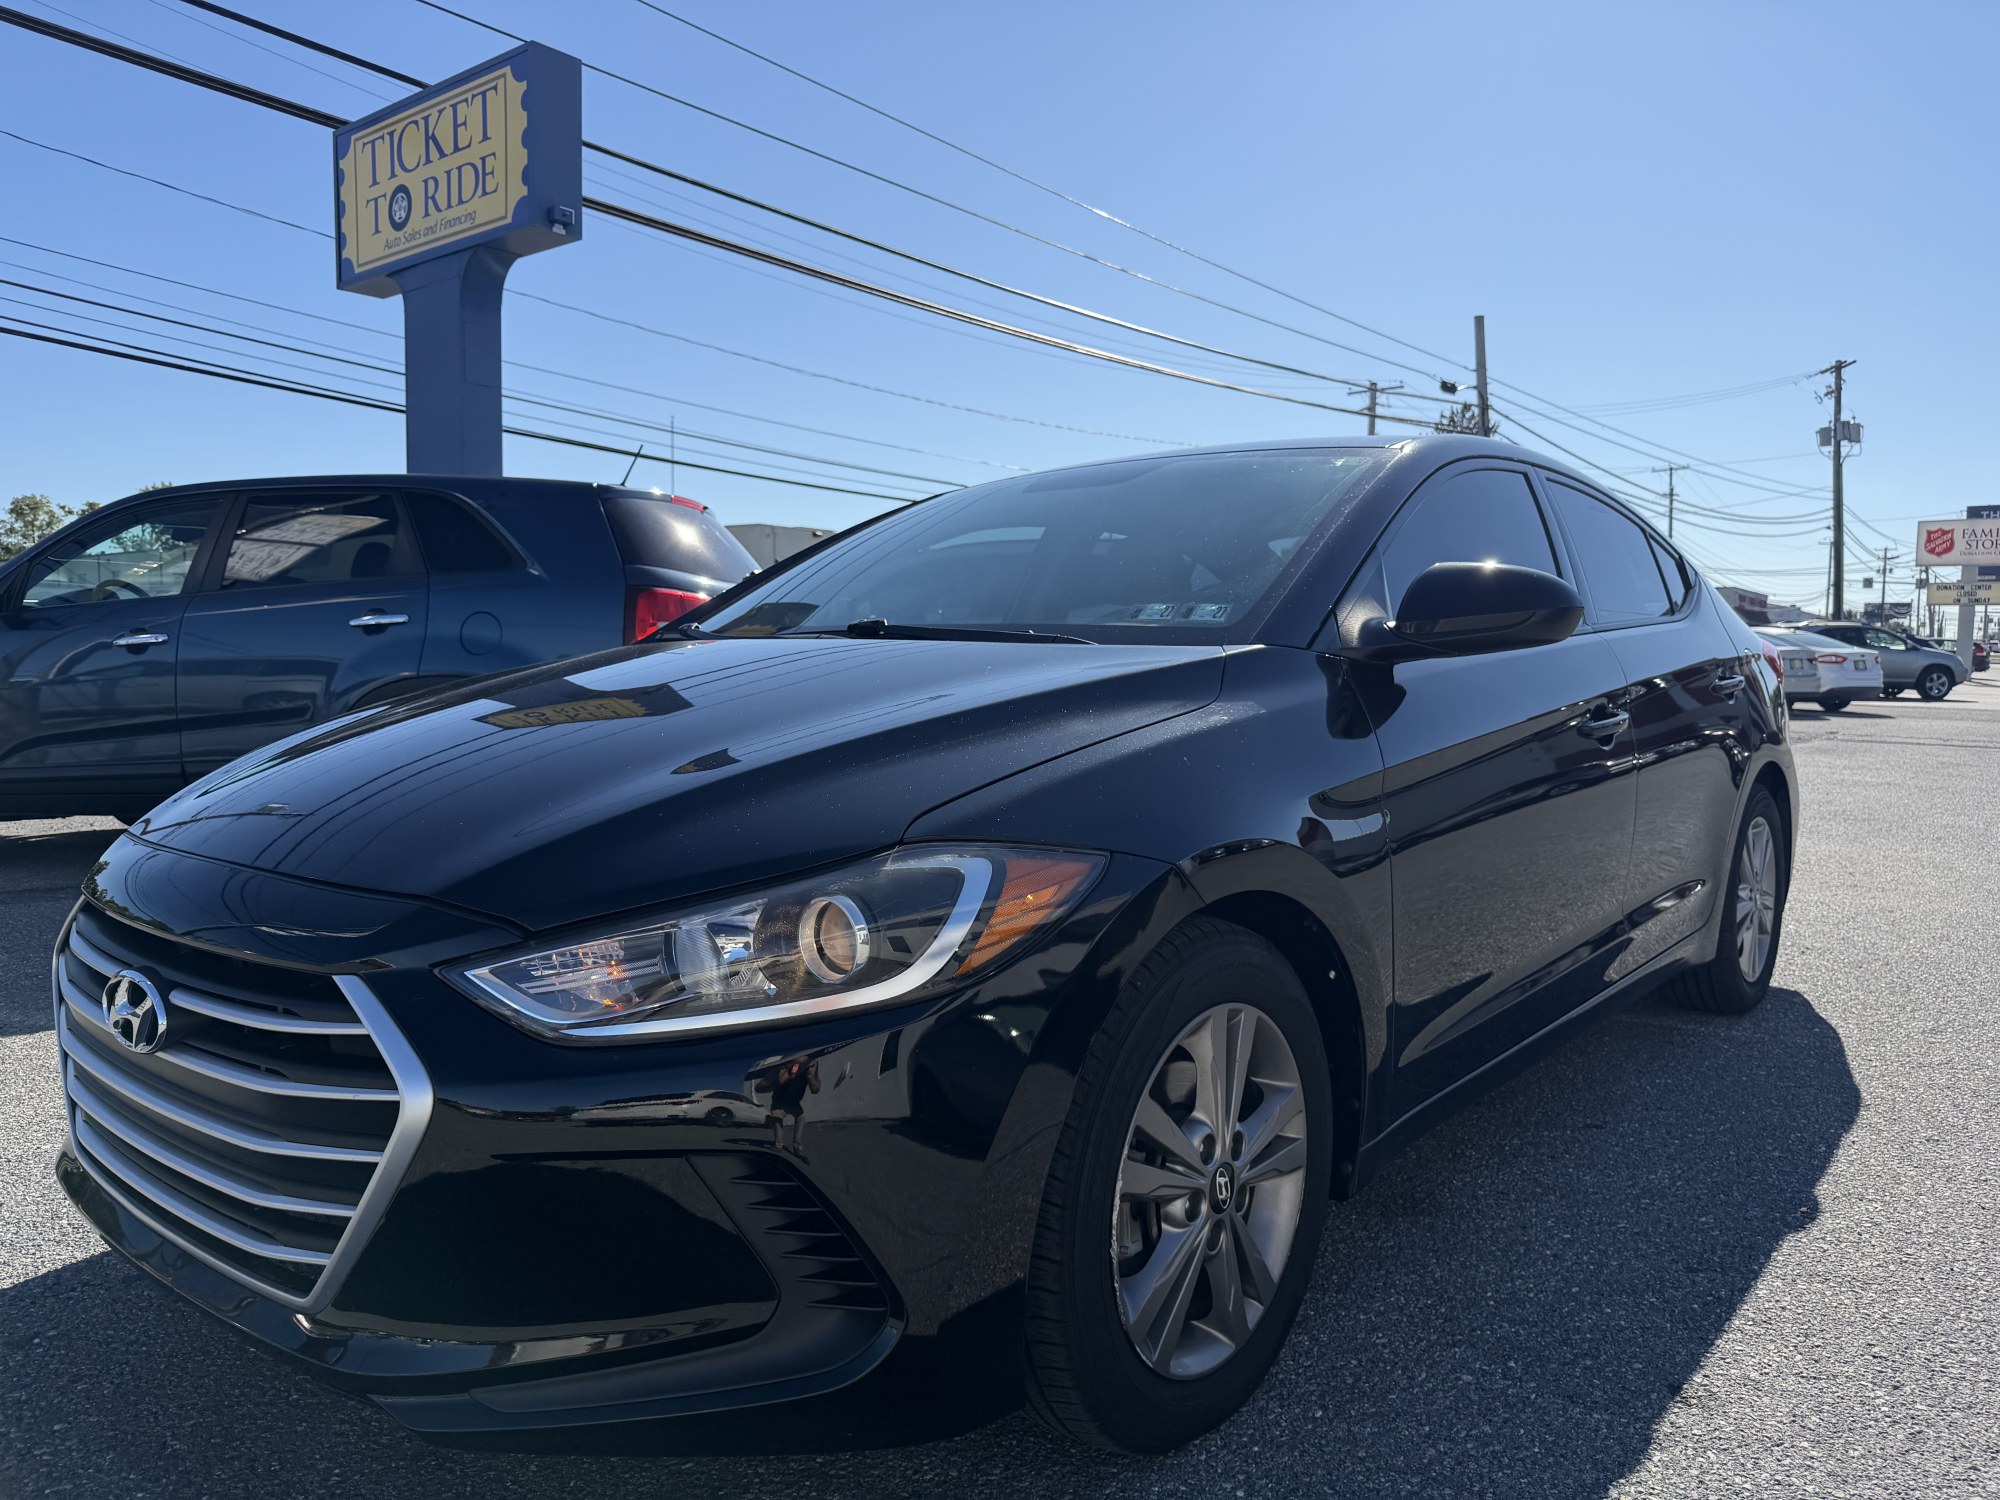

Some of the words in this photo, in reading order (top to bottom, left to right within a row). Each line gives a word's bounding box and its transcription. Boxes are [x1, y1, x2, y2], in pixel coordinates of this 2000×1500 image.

[362, 84, 498, 188] TICKET
[366, 184, 412, 236] TO
[421, 152, 500, 219] RIDE
[383, 234, 402, 252] Auto
[402, 228, 422, 245] Sales
[422, 221, 439, 238] and
[439, 209, 477, 232] Financing
[1935, 540, 1951, 554] ARMY
[1160, 605, 1175, 618] 27
[1212, 606, 1228, 619] 27
